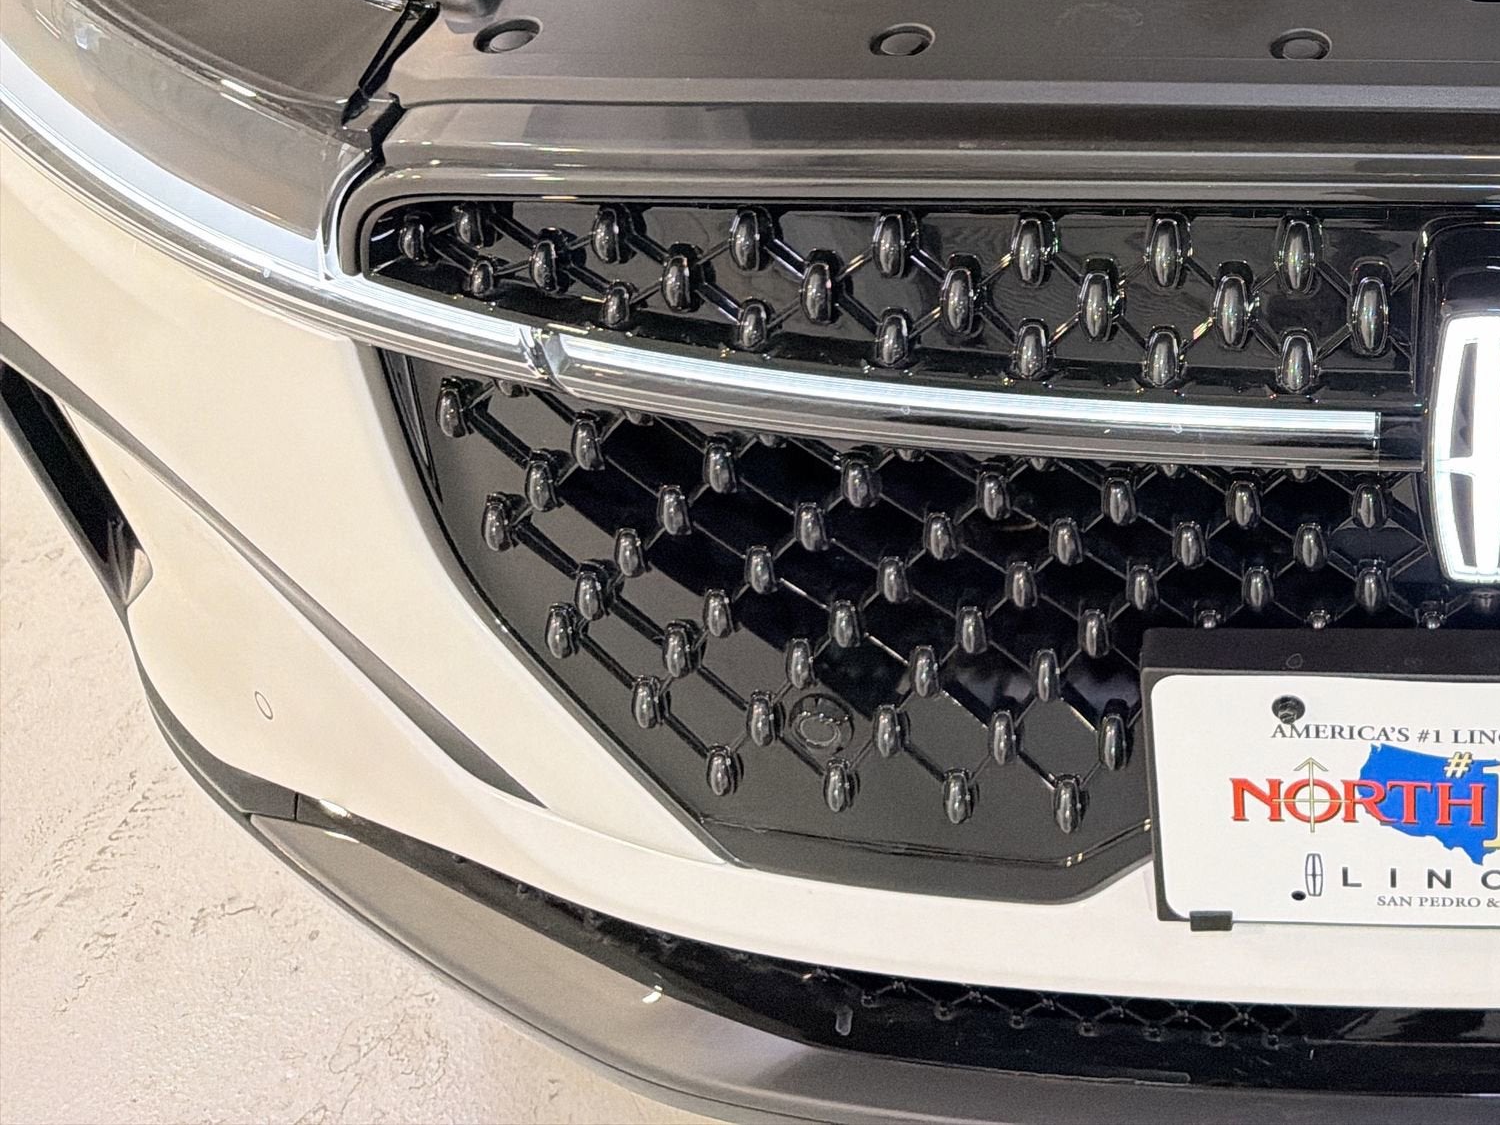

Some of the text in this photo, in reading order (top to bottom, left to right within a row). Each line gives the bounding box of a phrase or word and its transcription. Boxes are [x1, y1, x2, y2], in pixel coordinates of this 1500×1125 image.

[1270, 723, 1411, 743] AMERICA'S
[1416, 728, 1444, 744] #1
[1229, 777, 1487, 827] NORTH
[1376, 895, 1413, 908] SAN
[1417, 896, 1481, 909] PEDRO
[1486, 897, 1500, 909] &
